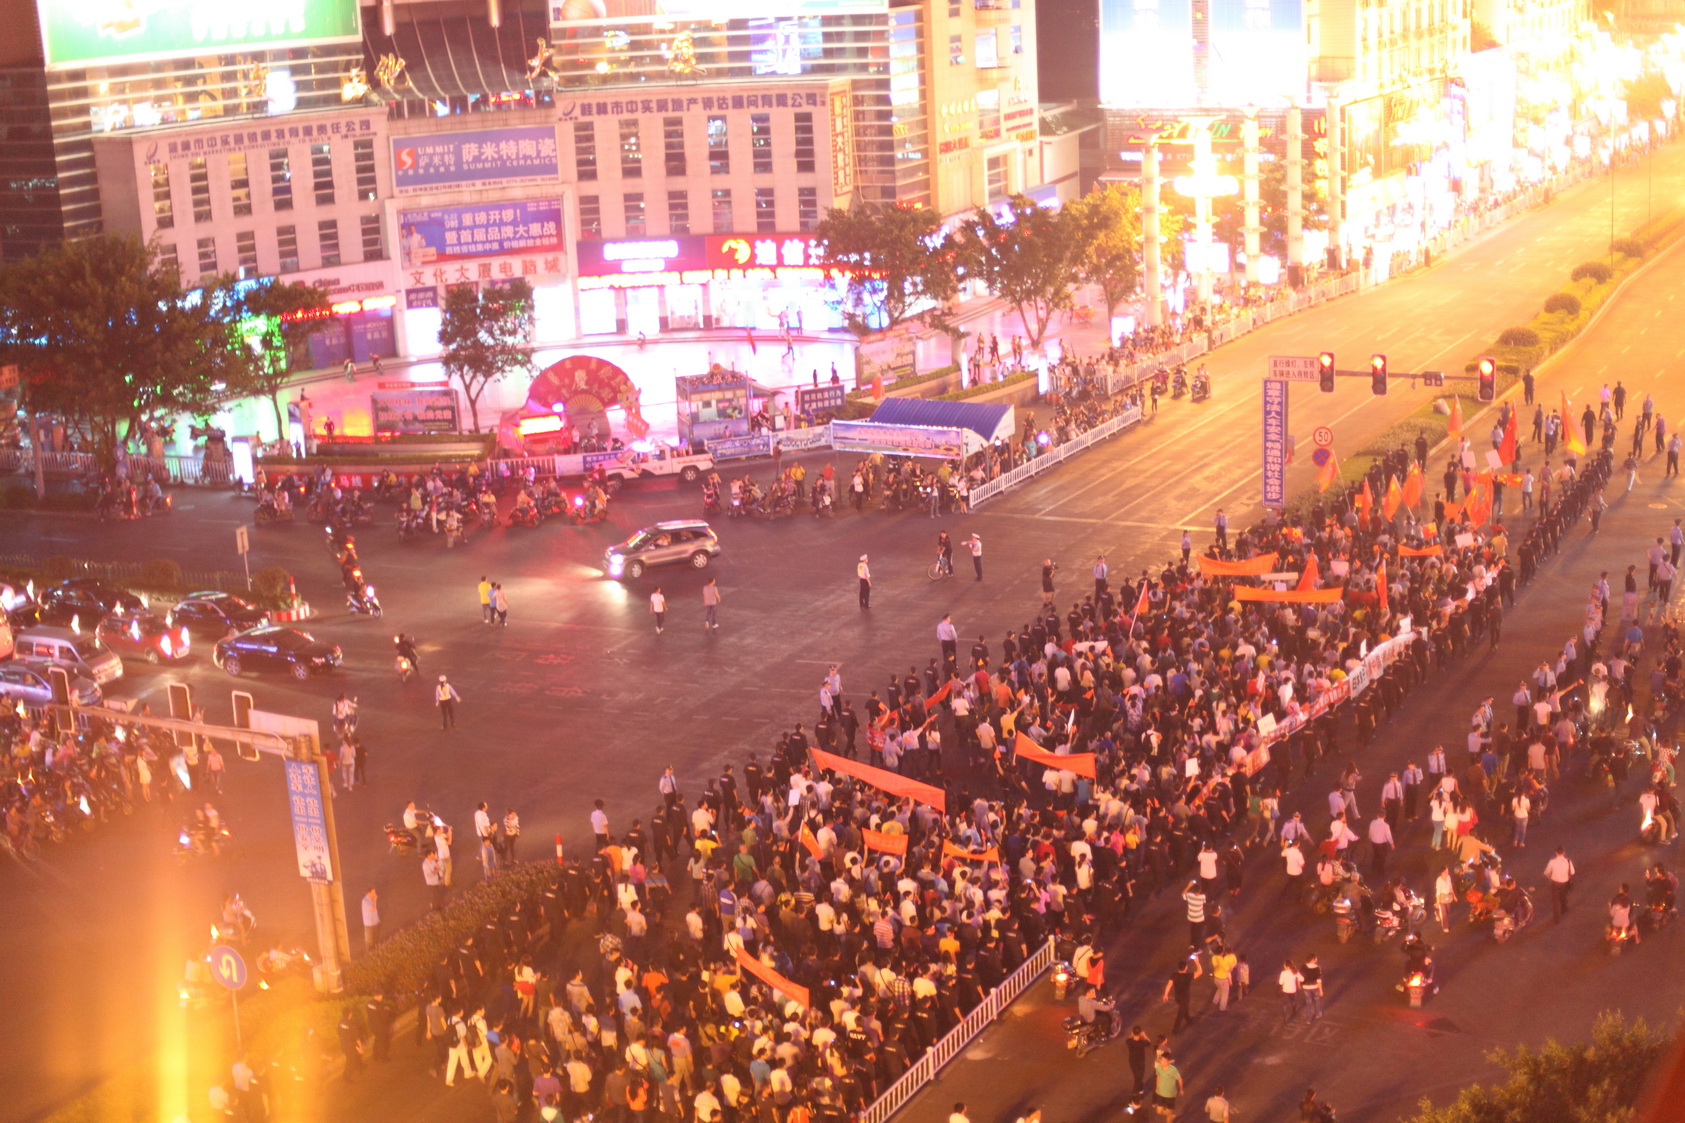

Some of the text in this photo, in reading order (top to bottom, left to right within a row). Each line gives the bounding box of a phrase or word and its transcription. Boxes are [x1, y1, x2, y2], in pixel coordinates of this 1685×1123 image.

[580, 92, 818, 117] 桂林市中实房地产评估顾问有限公司
[1211, 121, 1232, 138] IN
[461, 137, 557, 163] 萨米特陶瓷
[418, 153, 455, 167] 萨米特
[462, 157, 558, 170] SUMMIT CERAMICS
[410, 256, 562, 286] 文化大厦电脑城
[312, 277, 341, 288] China
[1318, 431, 1329, 442] 50
[289, 763, 303, 793] 人让车
[302, 764, 317, 794] 车让人
[849, 1032, 867, 1040] NAVY
